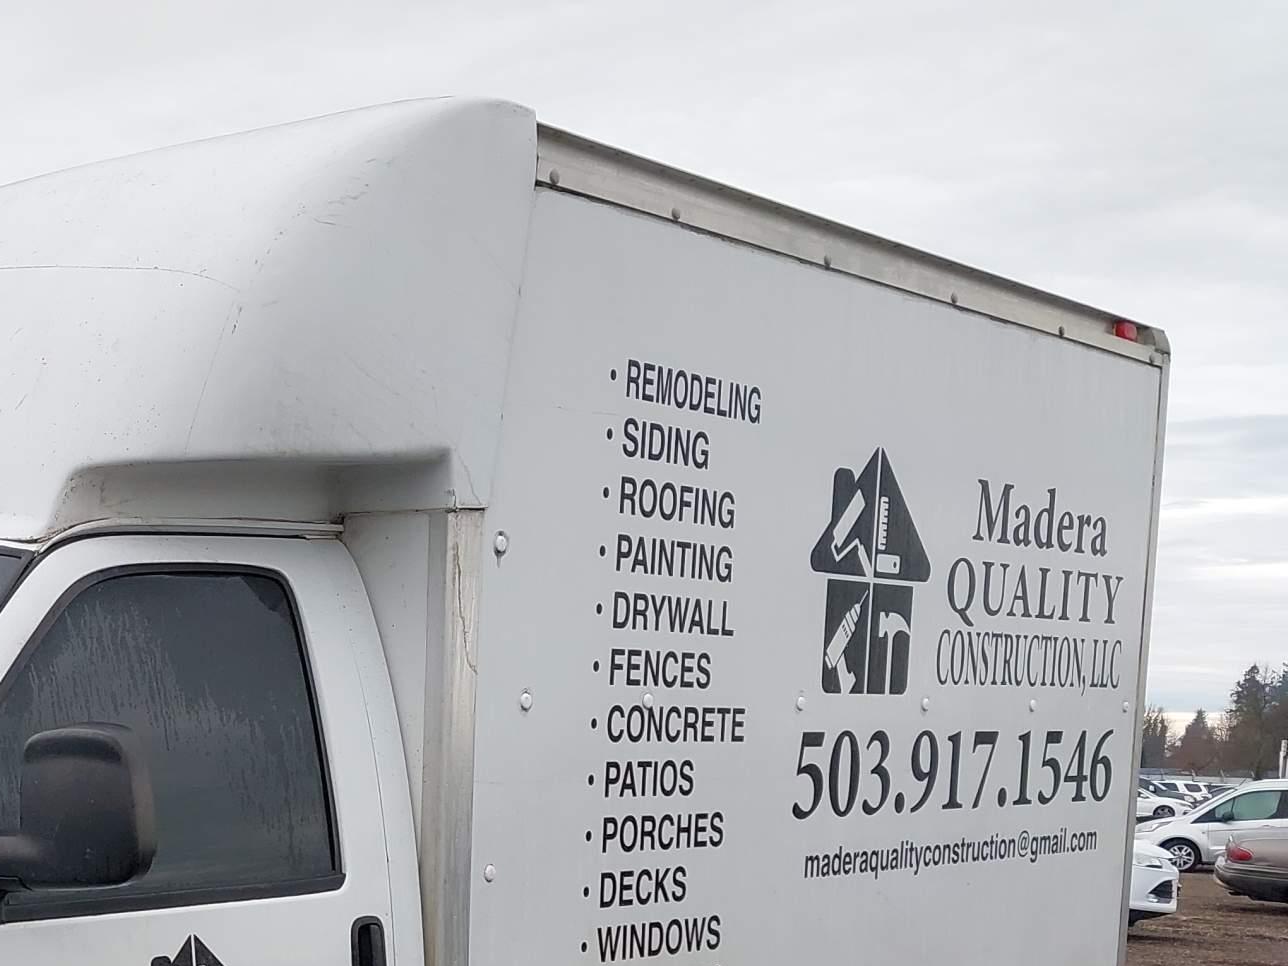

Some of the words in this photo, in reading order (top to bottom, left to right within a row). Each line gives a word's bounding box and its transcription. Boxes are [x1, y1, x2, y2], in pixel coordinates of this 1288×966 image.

[625, 359, 762, 424] REMODELING
[622, 418, 710, 470] SIDING
[619, 476, 735, 529] ROOFING
[972, 478, 1108, 558] Madera
[615, 534, 733, 583] PAINTING
[612, 591, 735, 637] DRYWALL
[947, 557, 1124, 627] QUALITY
[609, 648, 712, 690] FENCES
[936, 630, 1087, 697] CONSTRUCTION,
[1088, 638, 1123, 690] LLC
[606, 705, 746, 743] CONCRETE
[604, 759, 694, 798] PATIOS
[791, 728, 1114, 820] 503.917.1546
[602, 812, 724, 853] PORCHES
[804, 828, 1098, 880] maderaqualityconstruction@gmail.com
[599, 866, 687, 908] DECKS
[597, 915, 722, 963] WINDOWS
